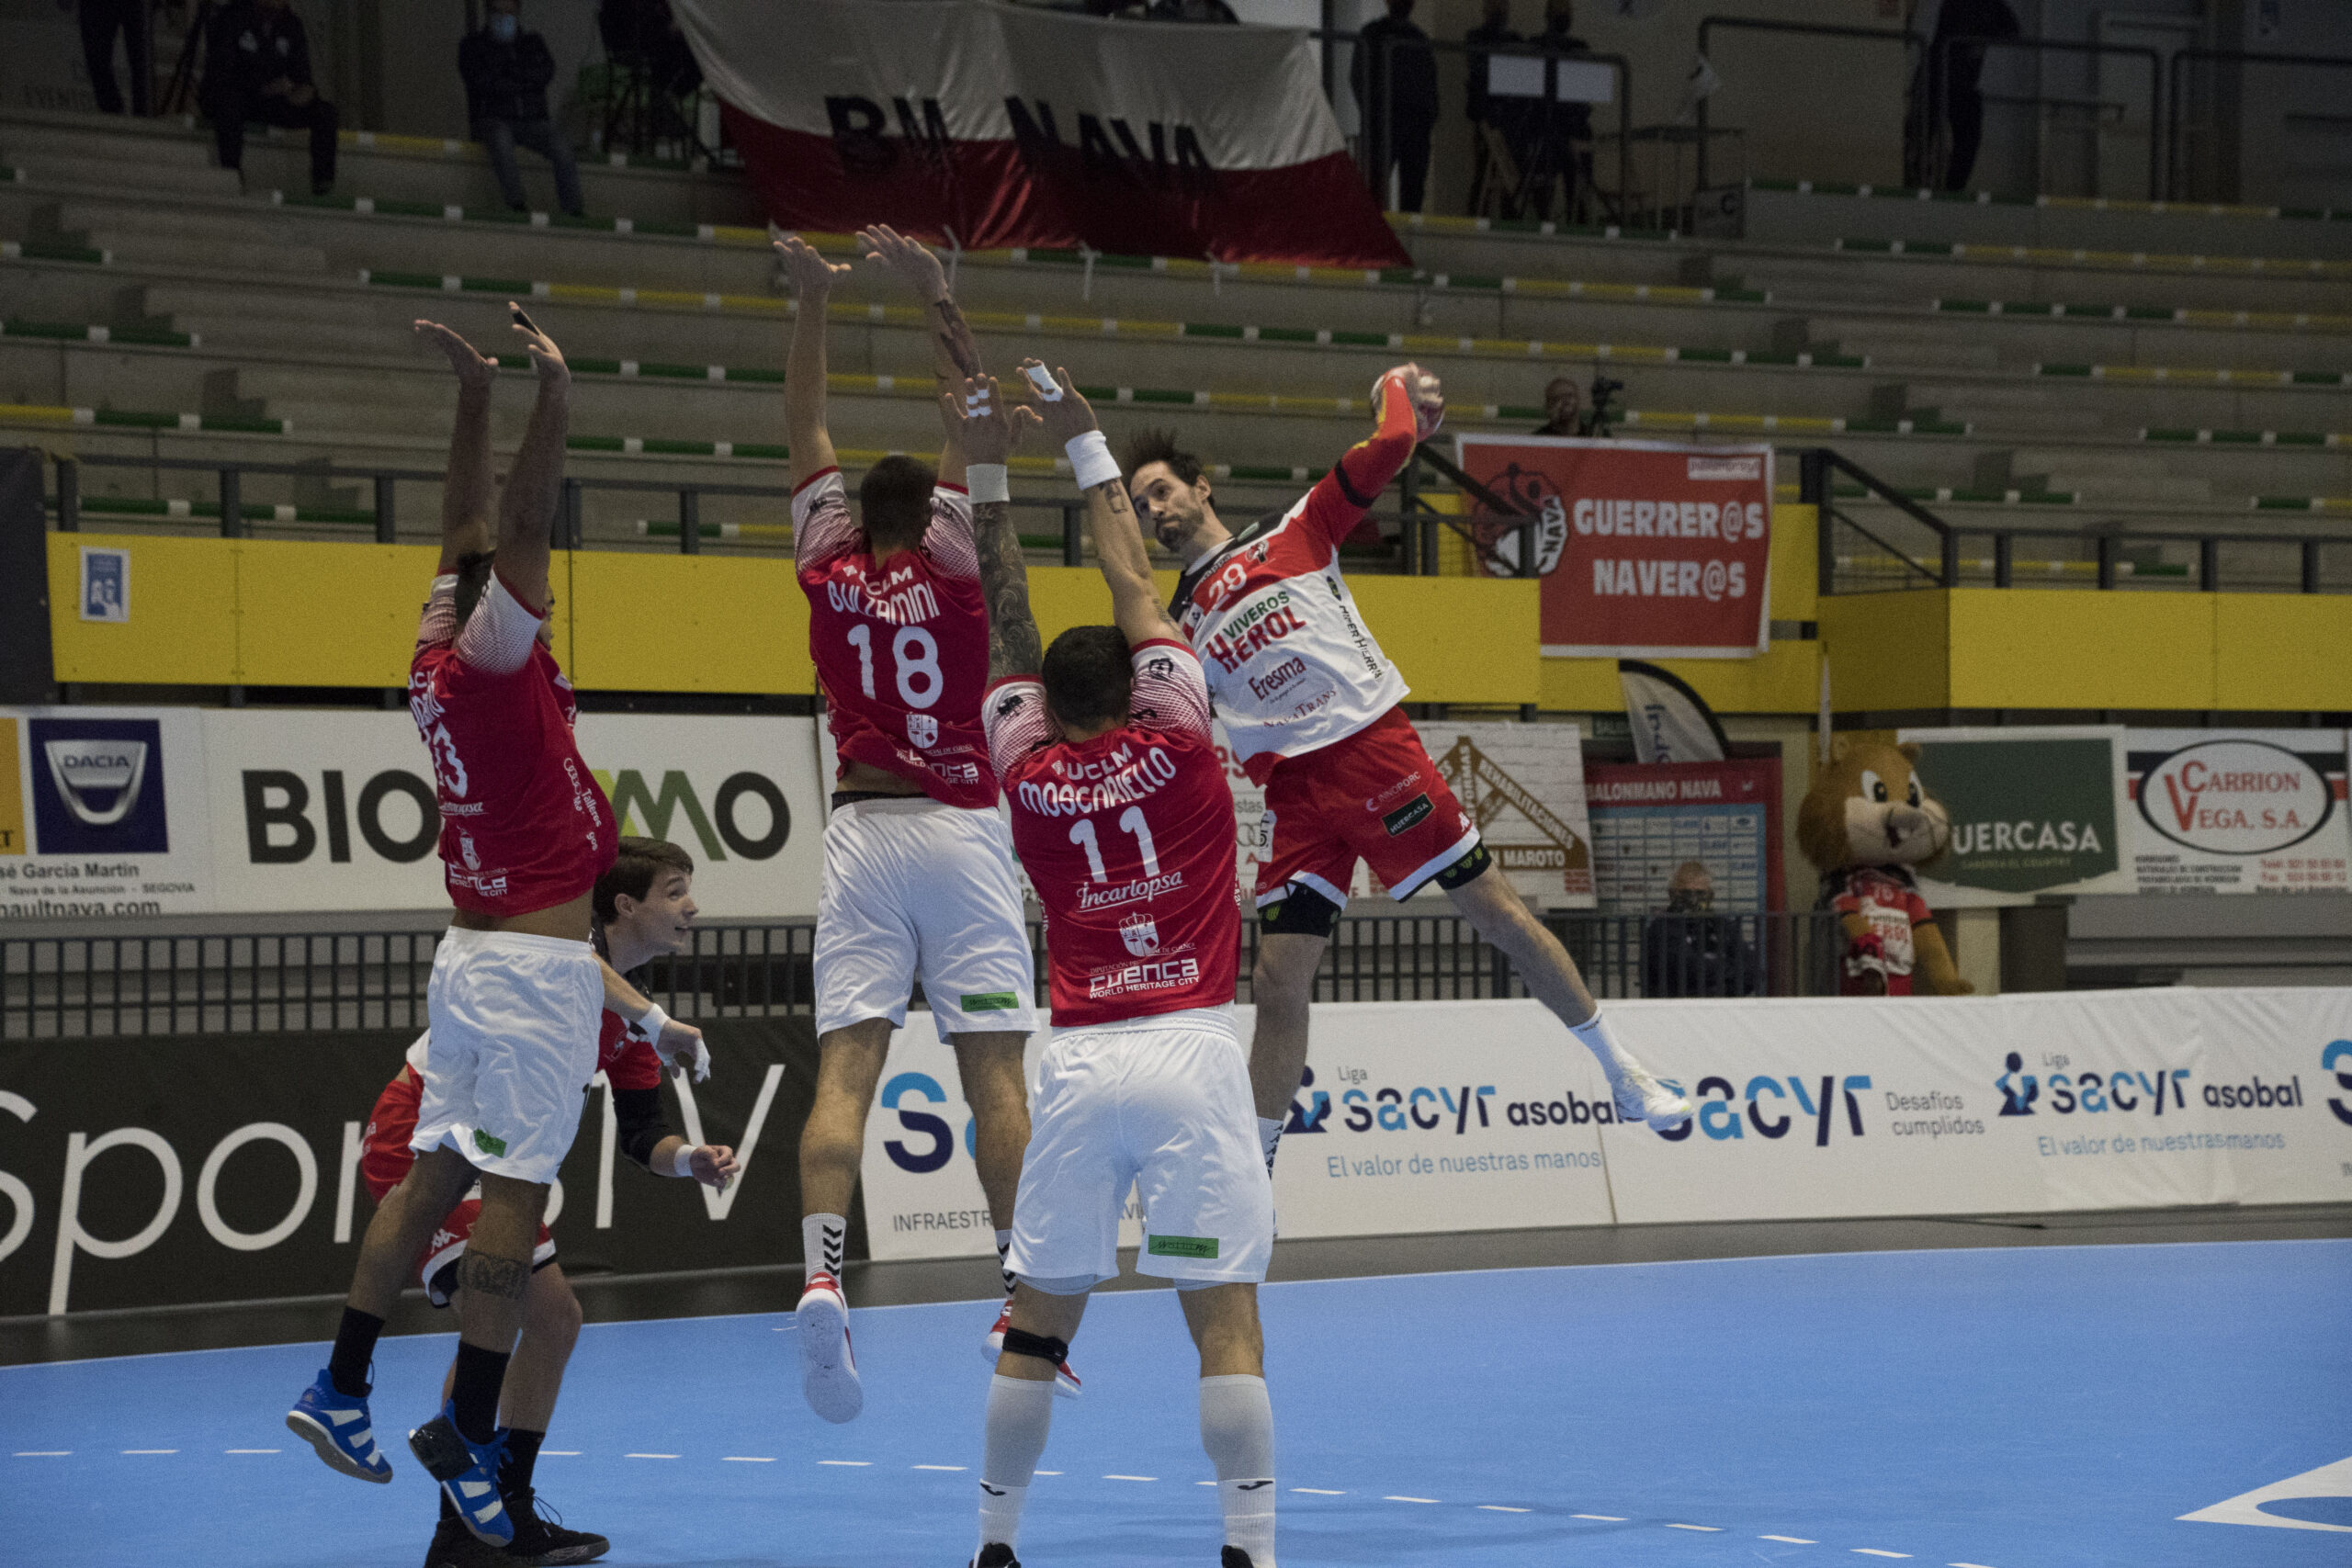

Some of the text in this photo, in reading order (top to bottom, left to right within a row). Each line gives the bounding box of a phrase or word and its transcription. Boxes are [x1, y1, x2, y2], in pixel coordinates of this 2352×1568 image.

[1005, 96, 1218, 189] NAVA
[1573, 498, 1765, 543] GUERRER@S
[1592, 558, 1746, 602] NAVER@S
[1223, 591, 1290, 638] VIVEROS
[1205, 605, 1306, 674] HEROL
[847, 624, 944, 709] 18
[1249, 657, 1306, 701] Eresma
[63, 755, 130, 769] DACIA
[1067, 742, 1134, 780] UCLM
[2181, 761, 2301, 794] CARRION
[1018, 747, 1176, 818] MOSCARIELLO
[1680, 779, 1723, 799] NAVA
[1389, 802, 1429, 834] HUERCASA
[1069, 806, 1161, 883] 11
[1951, 820, 2103, 855] UERCASA
[1504, 850, 1566, 866] MAROTO
[1077, 871, 1183, 909] Incarlopsa
[1089, 976, 1200, 999] WORLD HERITAGE CITY
[1338, 1066, 1368, 1085] Liga
[2042, 1053, 2070, 1069] Liga
[1342, 1086, 1624, 1134] sacyr asoba
[2048, 1069, 2190, 1116] sacyr
[2203, 1075, 2303, 1109] asobal
[1892, 1116, 1985, 1139] cumplidos
[2038, 1136, 2057, 1156] El
[2061, 1135, 2107, 1155] valor
[2113, 1134, 2135, 1153] de
[1328, 1150, 1601, 1178] El valor de nuestras manos
[893, 1210, 994, 1232] INFRAESTR
